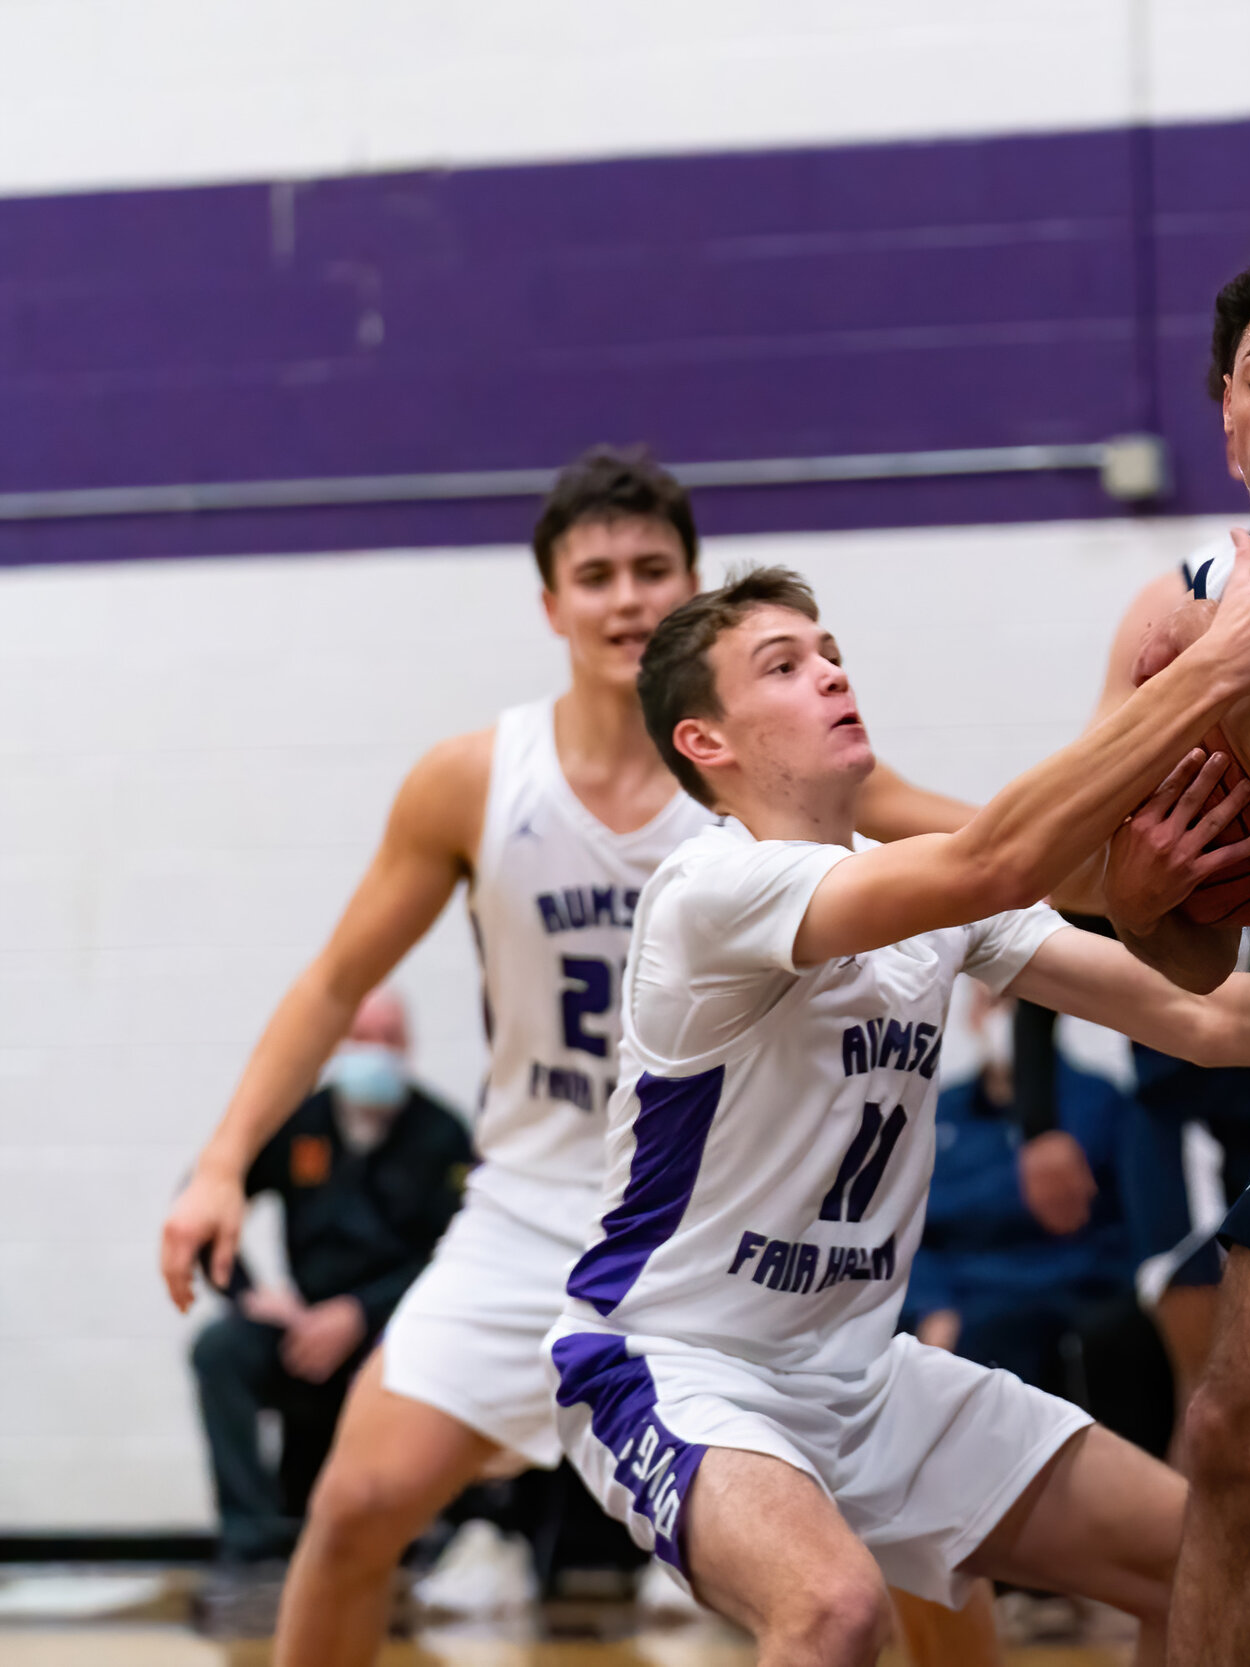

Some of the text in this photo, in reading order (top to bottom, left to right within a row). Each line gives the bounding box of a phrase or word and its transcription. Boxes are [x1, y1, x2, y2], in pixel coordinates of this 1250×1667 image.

[536, 884, 642, 934] RUMS
[560, 954, 632, 1058] 2
[818, 1101, 908, 1223] 11
[727, 1230, 819, 1295] FAIR
